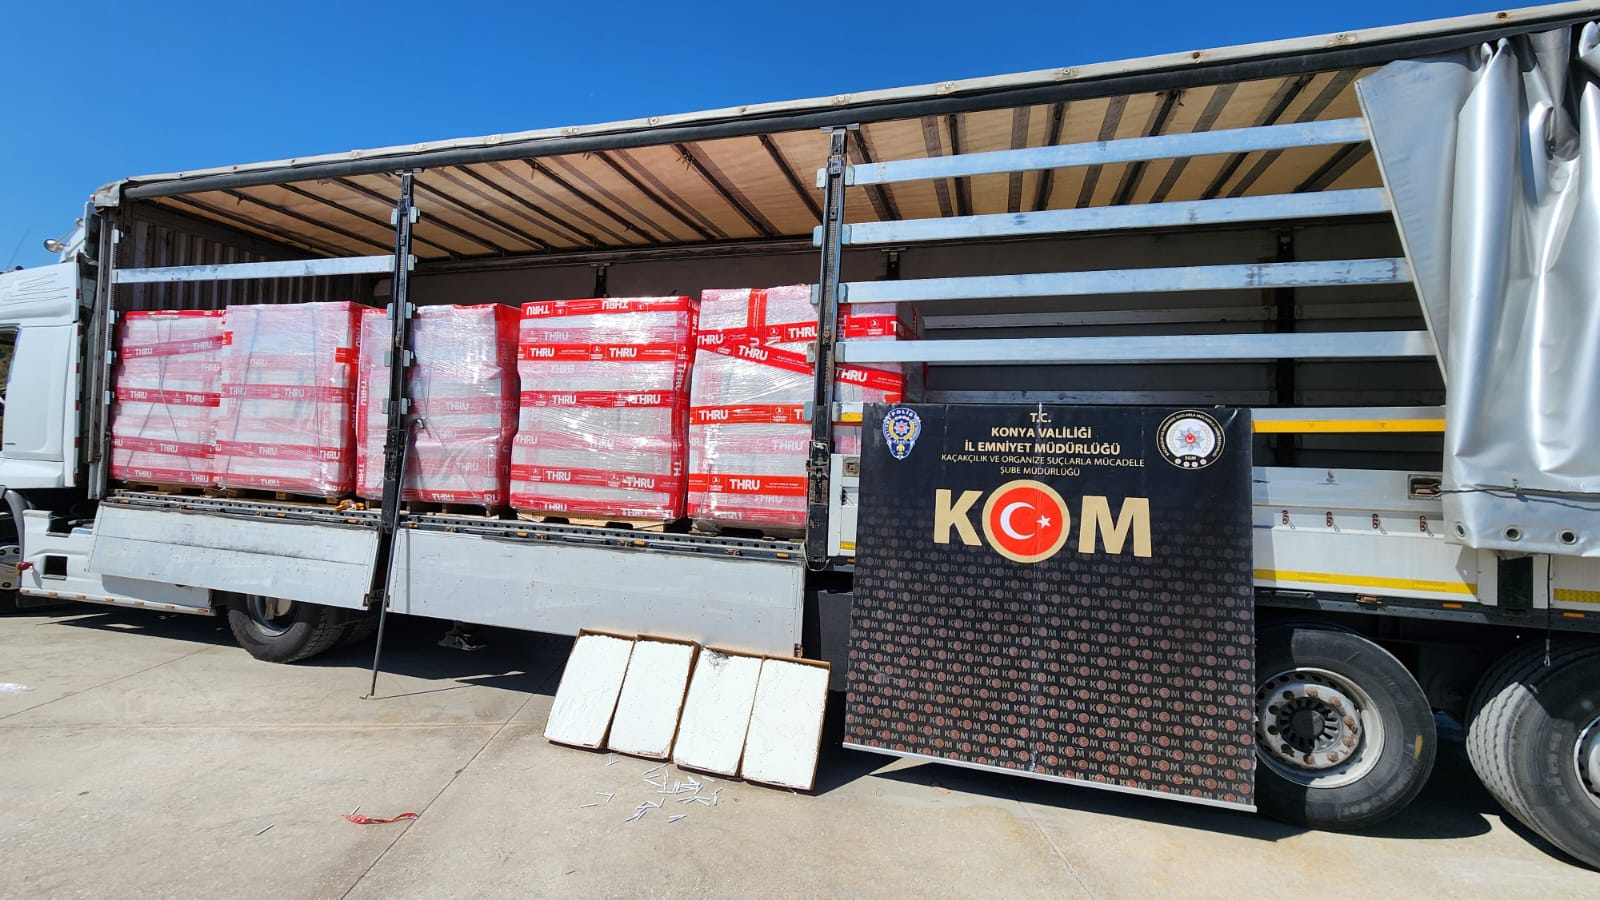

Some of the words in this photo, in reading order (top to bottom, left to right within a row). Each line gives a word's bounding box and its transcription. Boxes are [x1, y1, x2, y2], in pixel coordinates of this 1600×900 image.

[526, 304, 550, 316] THRU
[601, 300, 629, 310] THRU
[543, 331, 569, 340] THRU
[529, 347, 555, 358] THRU
[608, 347, 637, 358] THRU
[738, 345, 769, 361] THRU
[835, 367, 868, 383] THRU
[130, 390, 148, 400] THRU
[185, 394, 205, 403] THRU
[284, 388, 305, 398] THRU
[551, 394, 577, 404] THRU
[634, 394, 661, 404] THRU
[699, 409, 729, 421] THRU
[1030, 412, 1051, 423] T.C.
[991, 427, 1035, 438] KONYA
[1038, 426, 1092, 439] VALİLİĞİ
[515, 433, 538, 444] THRU
[160, 443, 178, 453] THRU
[773, 439, 804, 451] THRU
[964, 439, 975, 452] İL
[978, 440, 1032, 453] EMNİYET
[1034, 441, 1121, 455] MÜDÜRLÜĞÜ
[258, 446, 278, 456] THRU
[320, 450, 340, 460] THRU
[456, 461, 480, 471] THRU
[941, 454, 988, 465] KAÇAKÇILIK
[989, 455, 1000, 464] VE
[1047, 456, 1092, 467] SUÇLARLA
[1094, 457, 1145, 467] MÜCADELE
[134, 469, 152, 478] THRU
[546, 470, 572, 481] THRU
[1000, 466, 1022, 475] ŞUBE
[1023, 466, 1080, 476] MÜDÜRLÜĞÜ
[626, 476, 655, 489] THRU
[729, 479, 760, 490] THRU
[544, 503, 568, 512] THRU
[933, 479, 1152, 564] KOM
